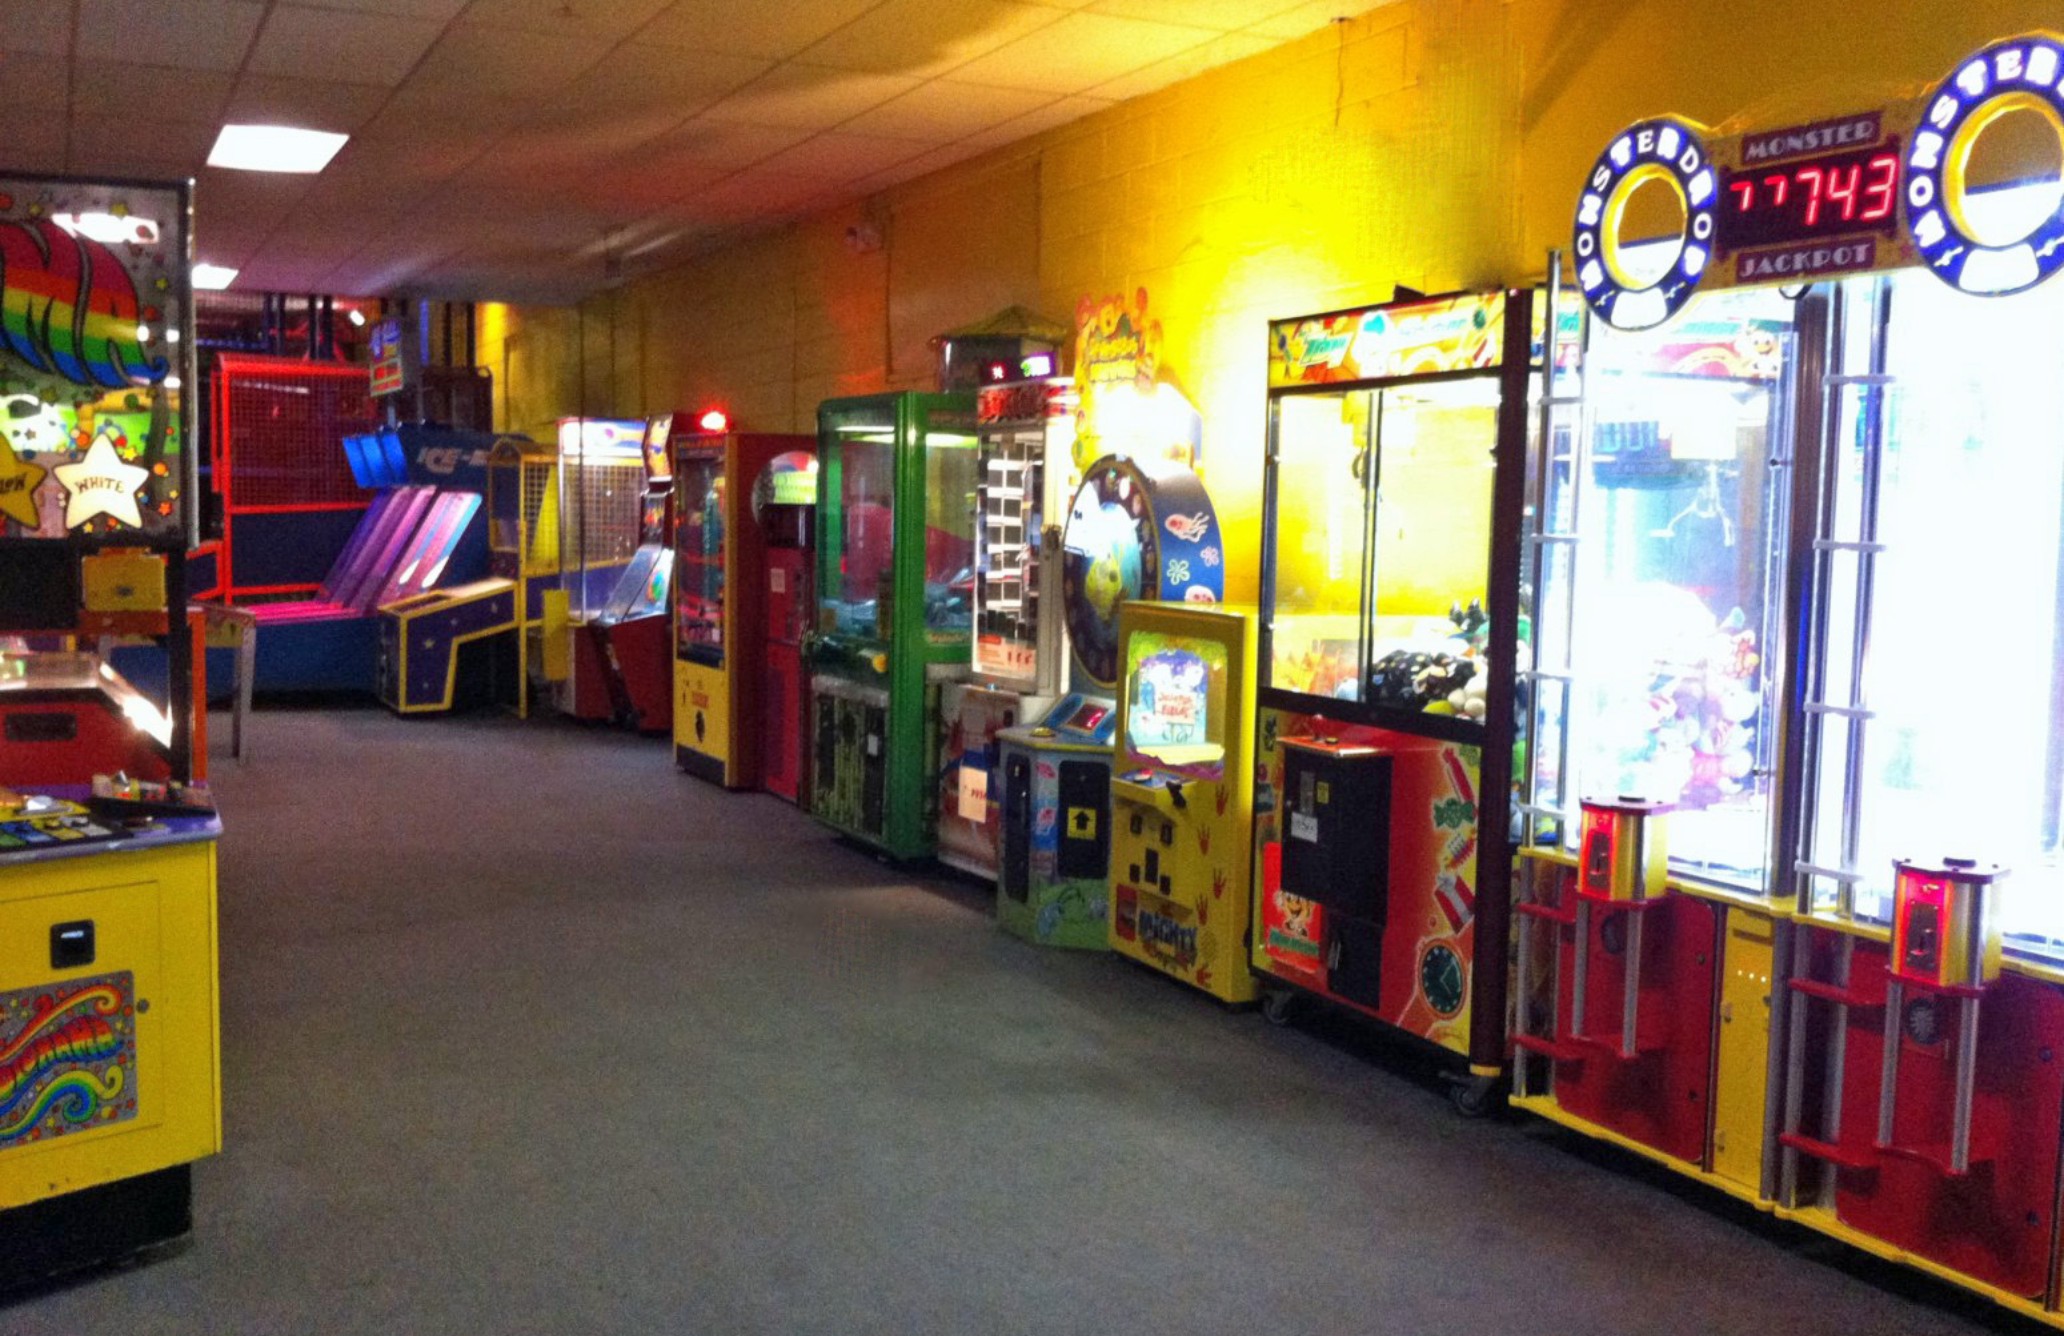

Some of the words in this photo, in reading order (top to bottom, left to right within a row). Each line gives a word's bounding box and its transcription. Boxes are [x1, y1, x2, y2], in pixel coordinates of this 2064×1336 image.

[1744, 120, 1876, 161] MONSTER
[1739, 243, 1871, 278] JACKPOT
[75, 476, 125, 495] WHITE
